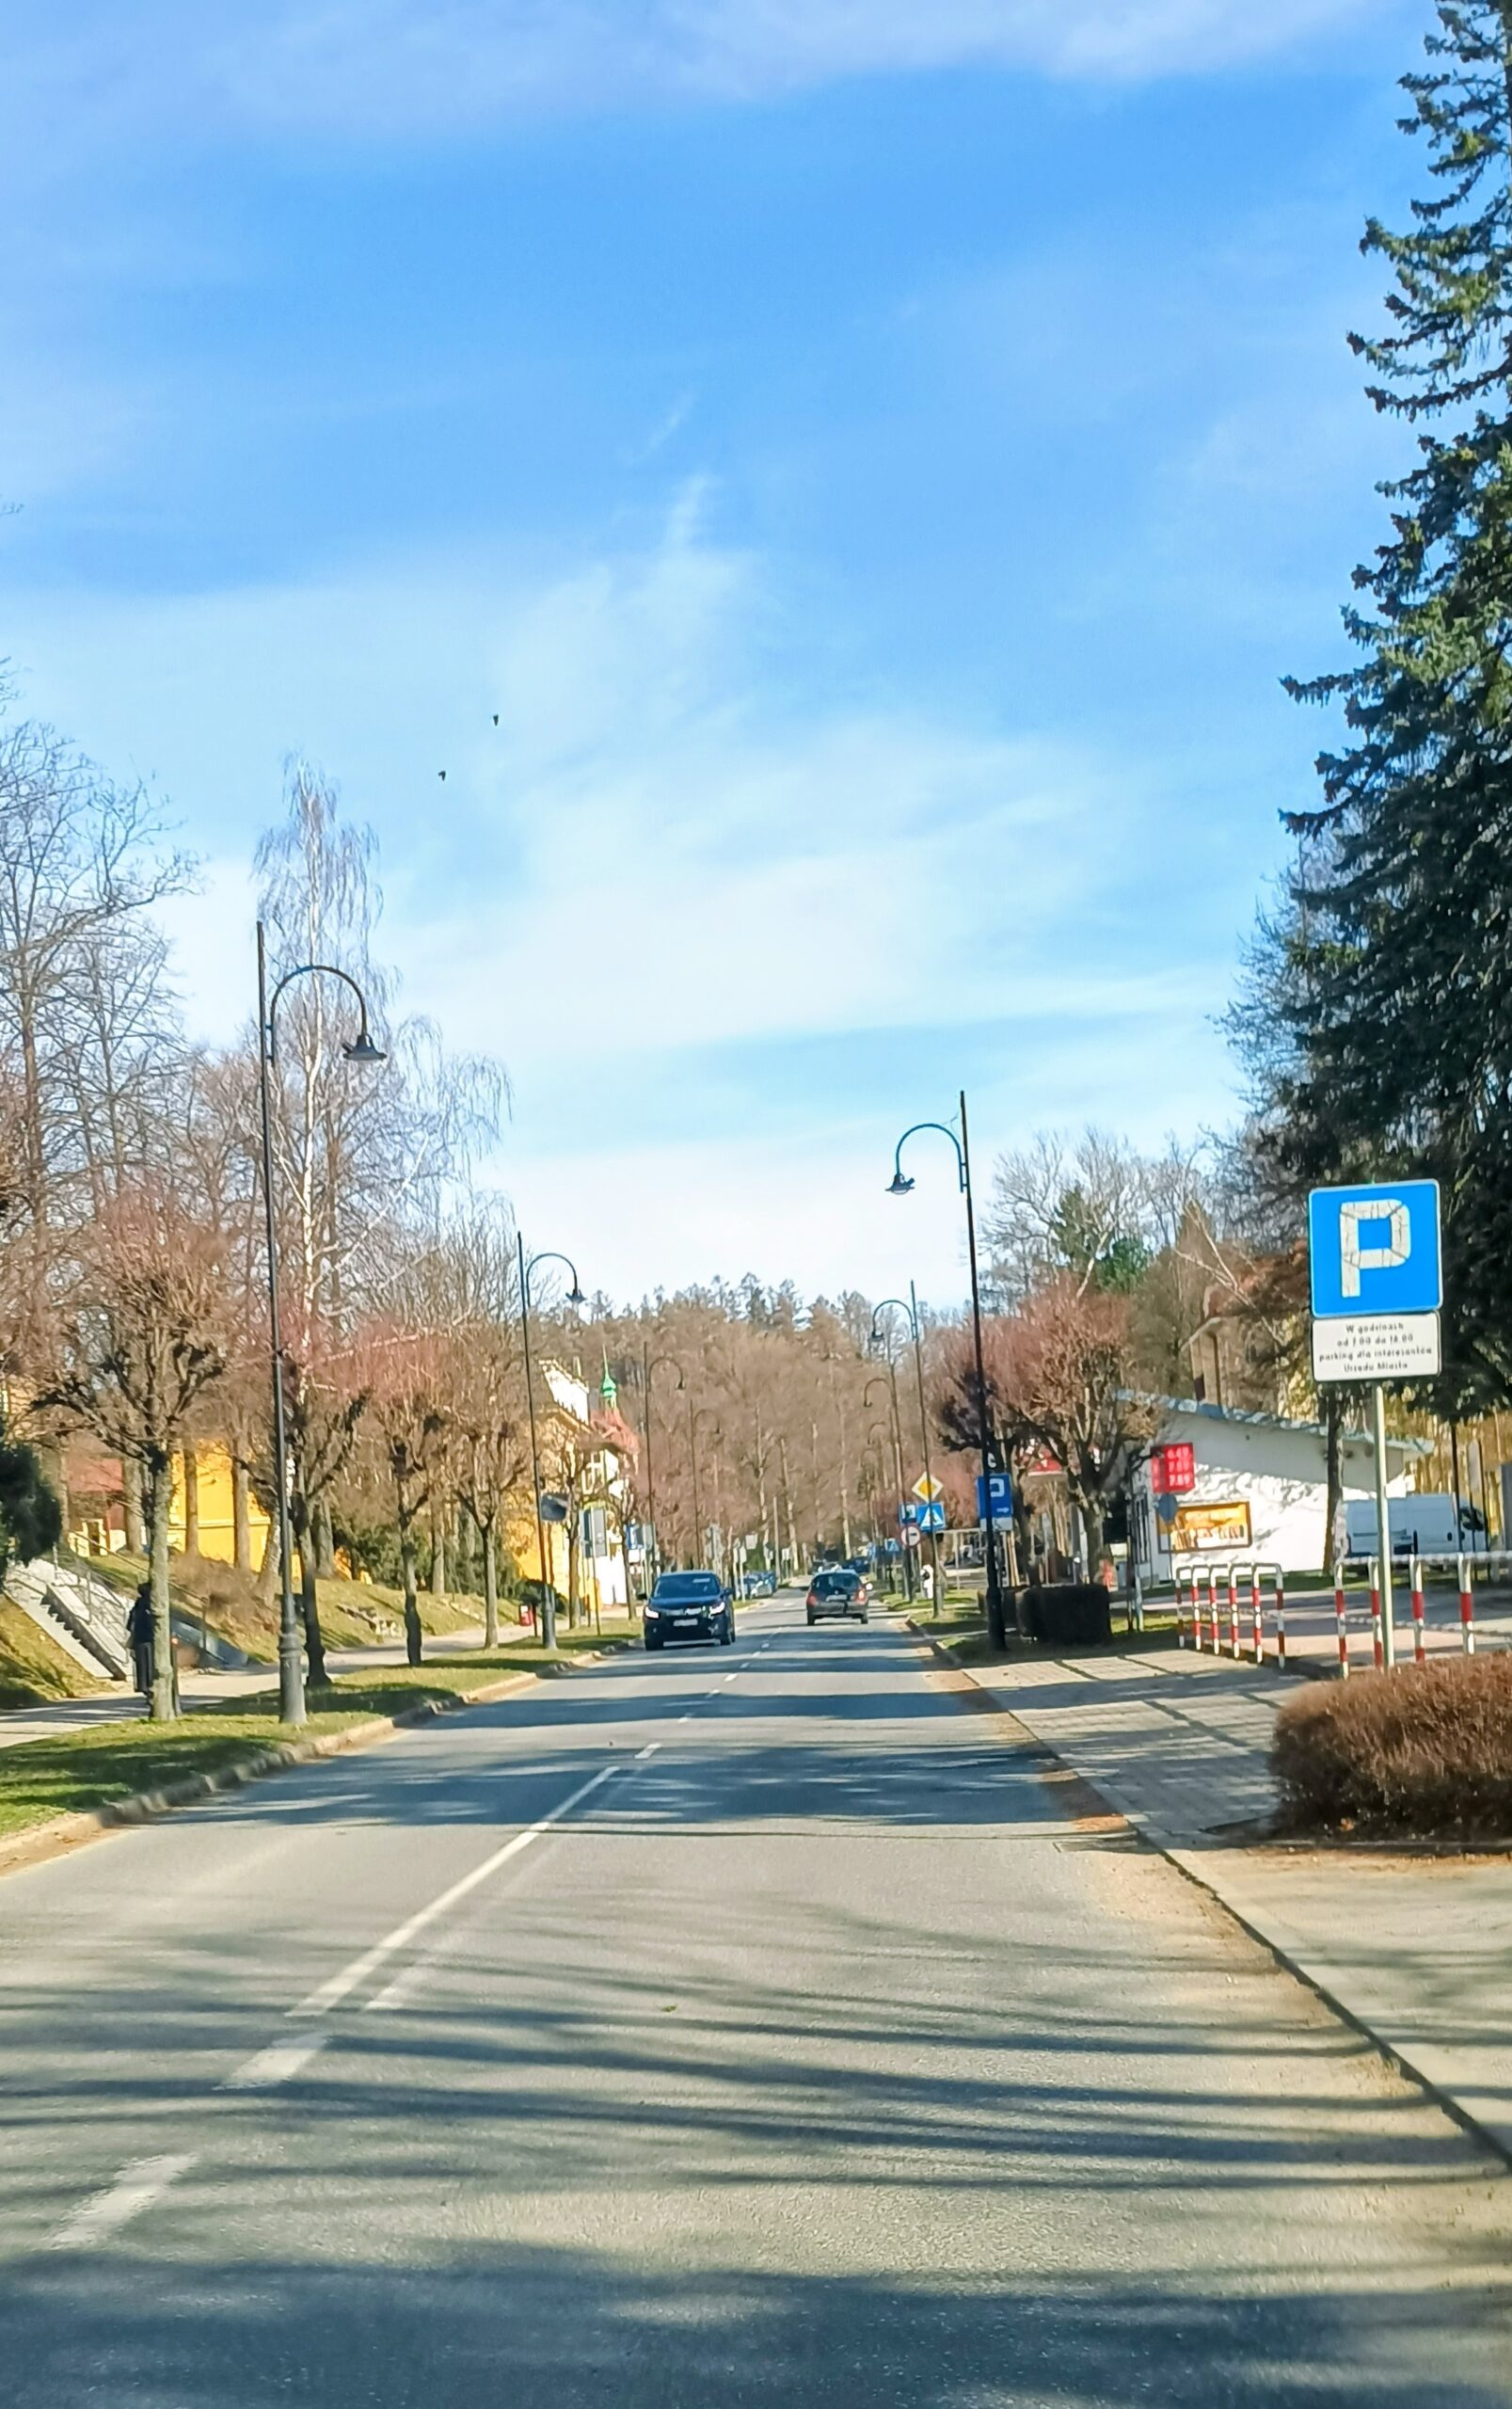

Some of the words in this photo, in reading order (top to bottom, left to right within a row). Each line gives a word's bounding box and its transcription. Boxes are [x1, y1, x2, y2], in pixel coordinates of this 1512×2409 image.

[1340, 1199, 1411, 1298] P
[1345, 1324, 1355, 1333] W
[1358, 1322, 1404, 1334] godzinach
[1337, 1338, 1348, 1347] od
[1375, 1335, 1386, 1345] do
[1319, 1352, 1353, 1363] parking
[1357, 1349, 1371, 1358] dla
[1377, 1361, 1408, 1370] Miasta
